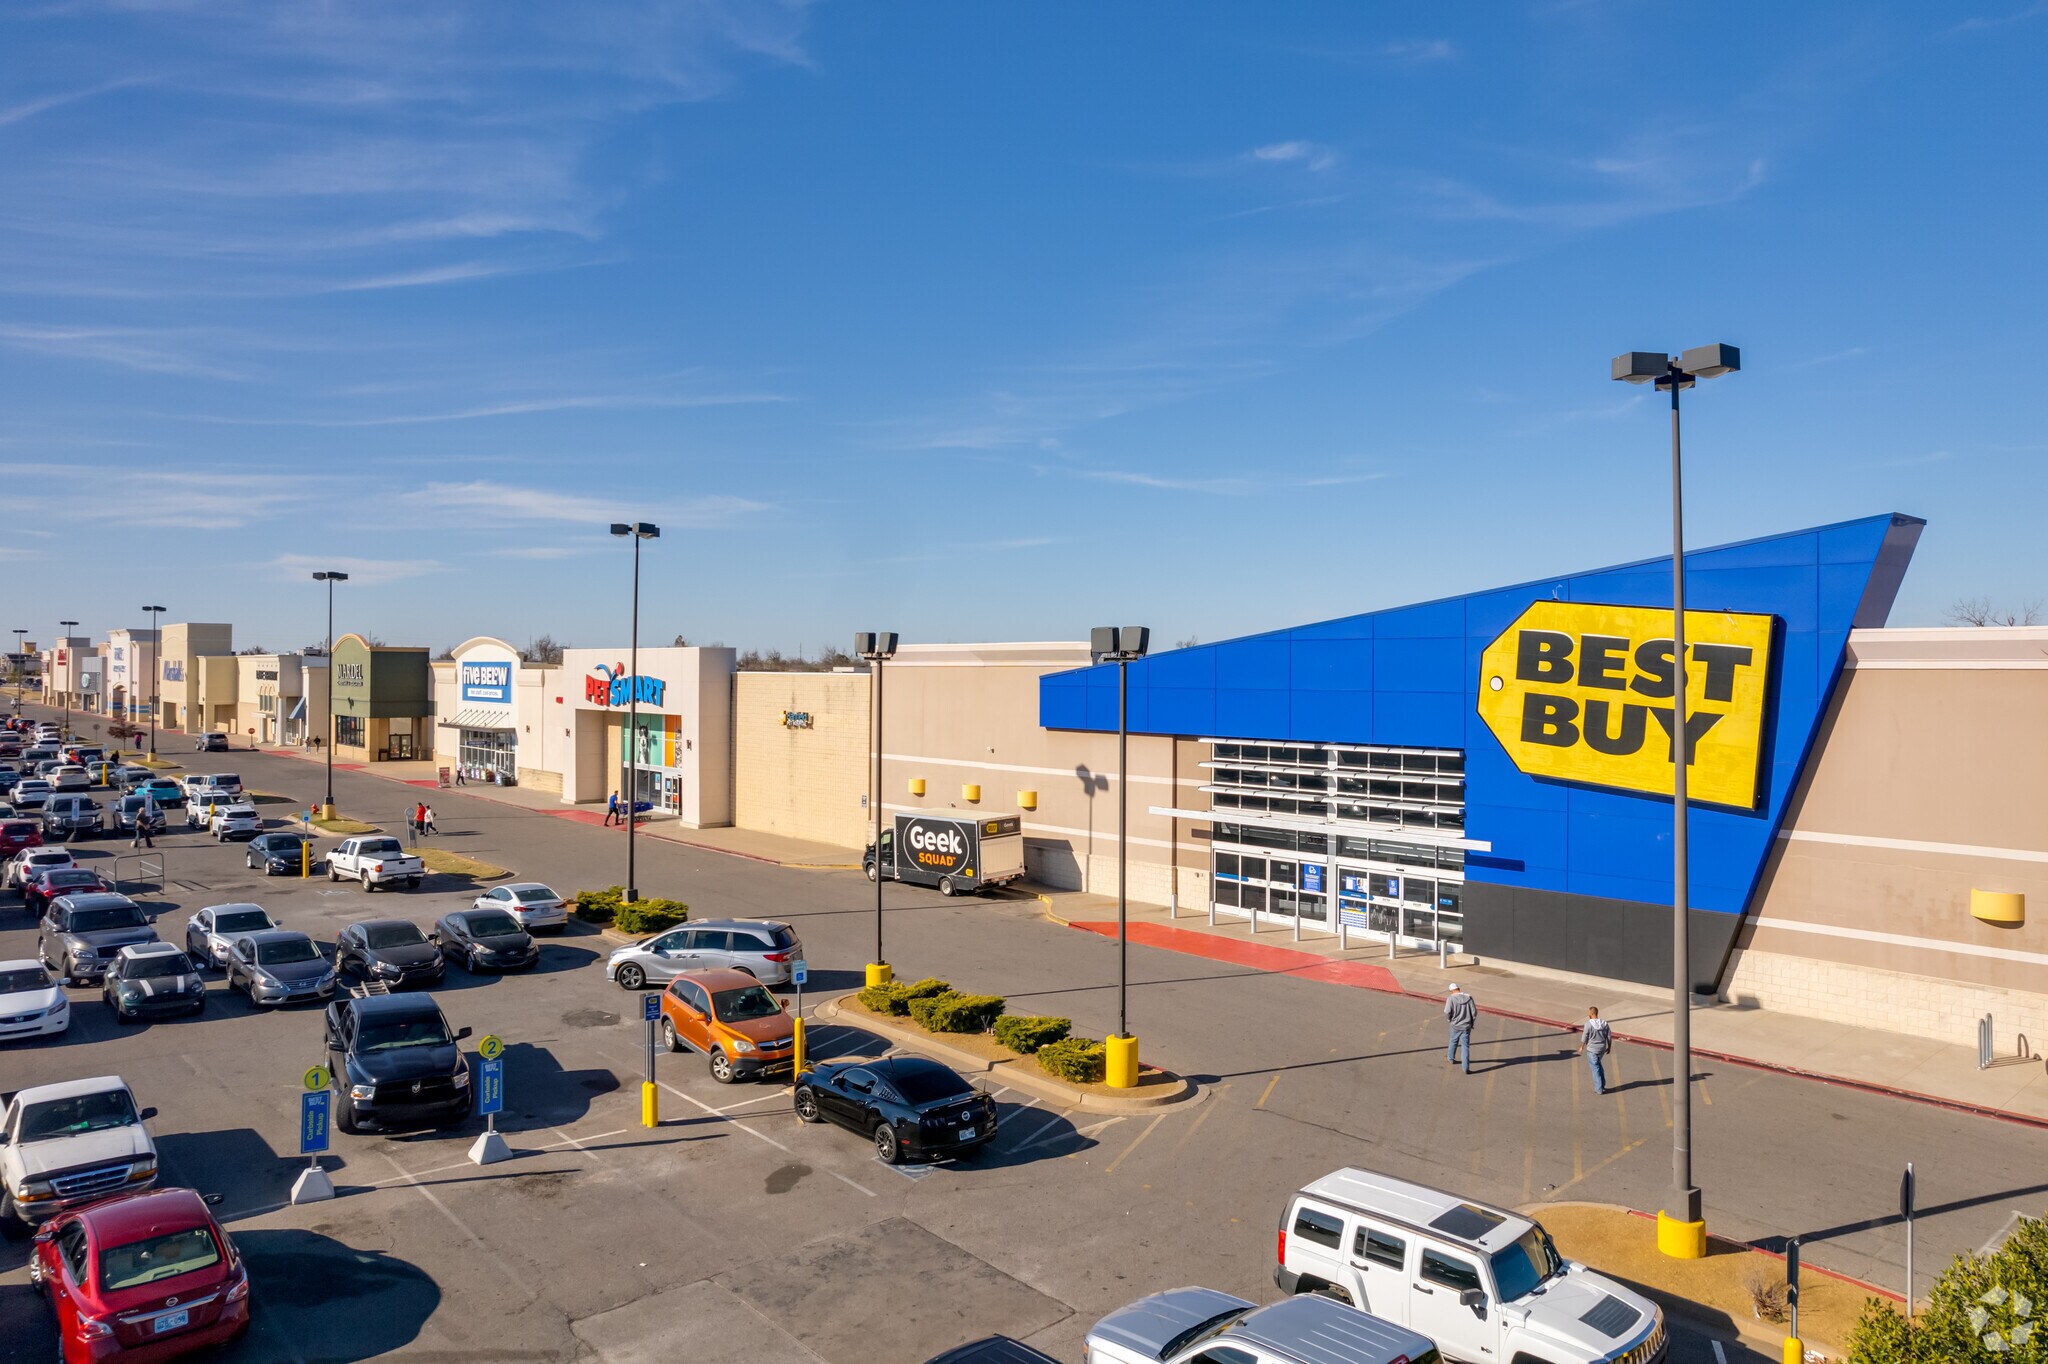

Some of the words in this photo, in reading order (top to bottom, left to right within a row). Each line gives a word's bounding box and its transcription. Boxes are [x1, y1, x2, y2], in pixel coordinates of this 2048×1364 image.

[481, 666, 507, 686] BELOW
[1516, 629, 1753, 703] BEST
[1520, 692, 1725, 766] BUY
[910, 825, 962, 854] Geek
[918, 852, 955, 867] SQUAD
[487, 1041, 496, 1054] 2
[311, 1072, 319, 1086] 1
[306, 1110, 315, 1140] Curbside
[316, 1112, 325, 1136] Pickup
